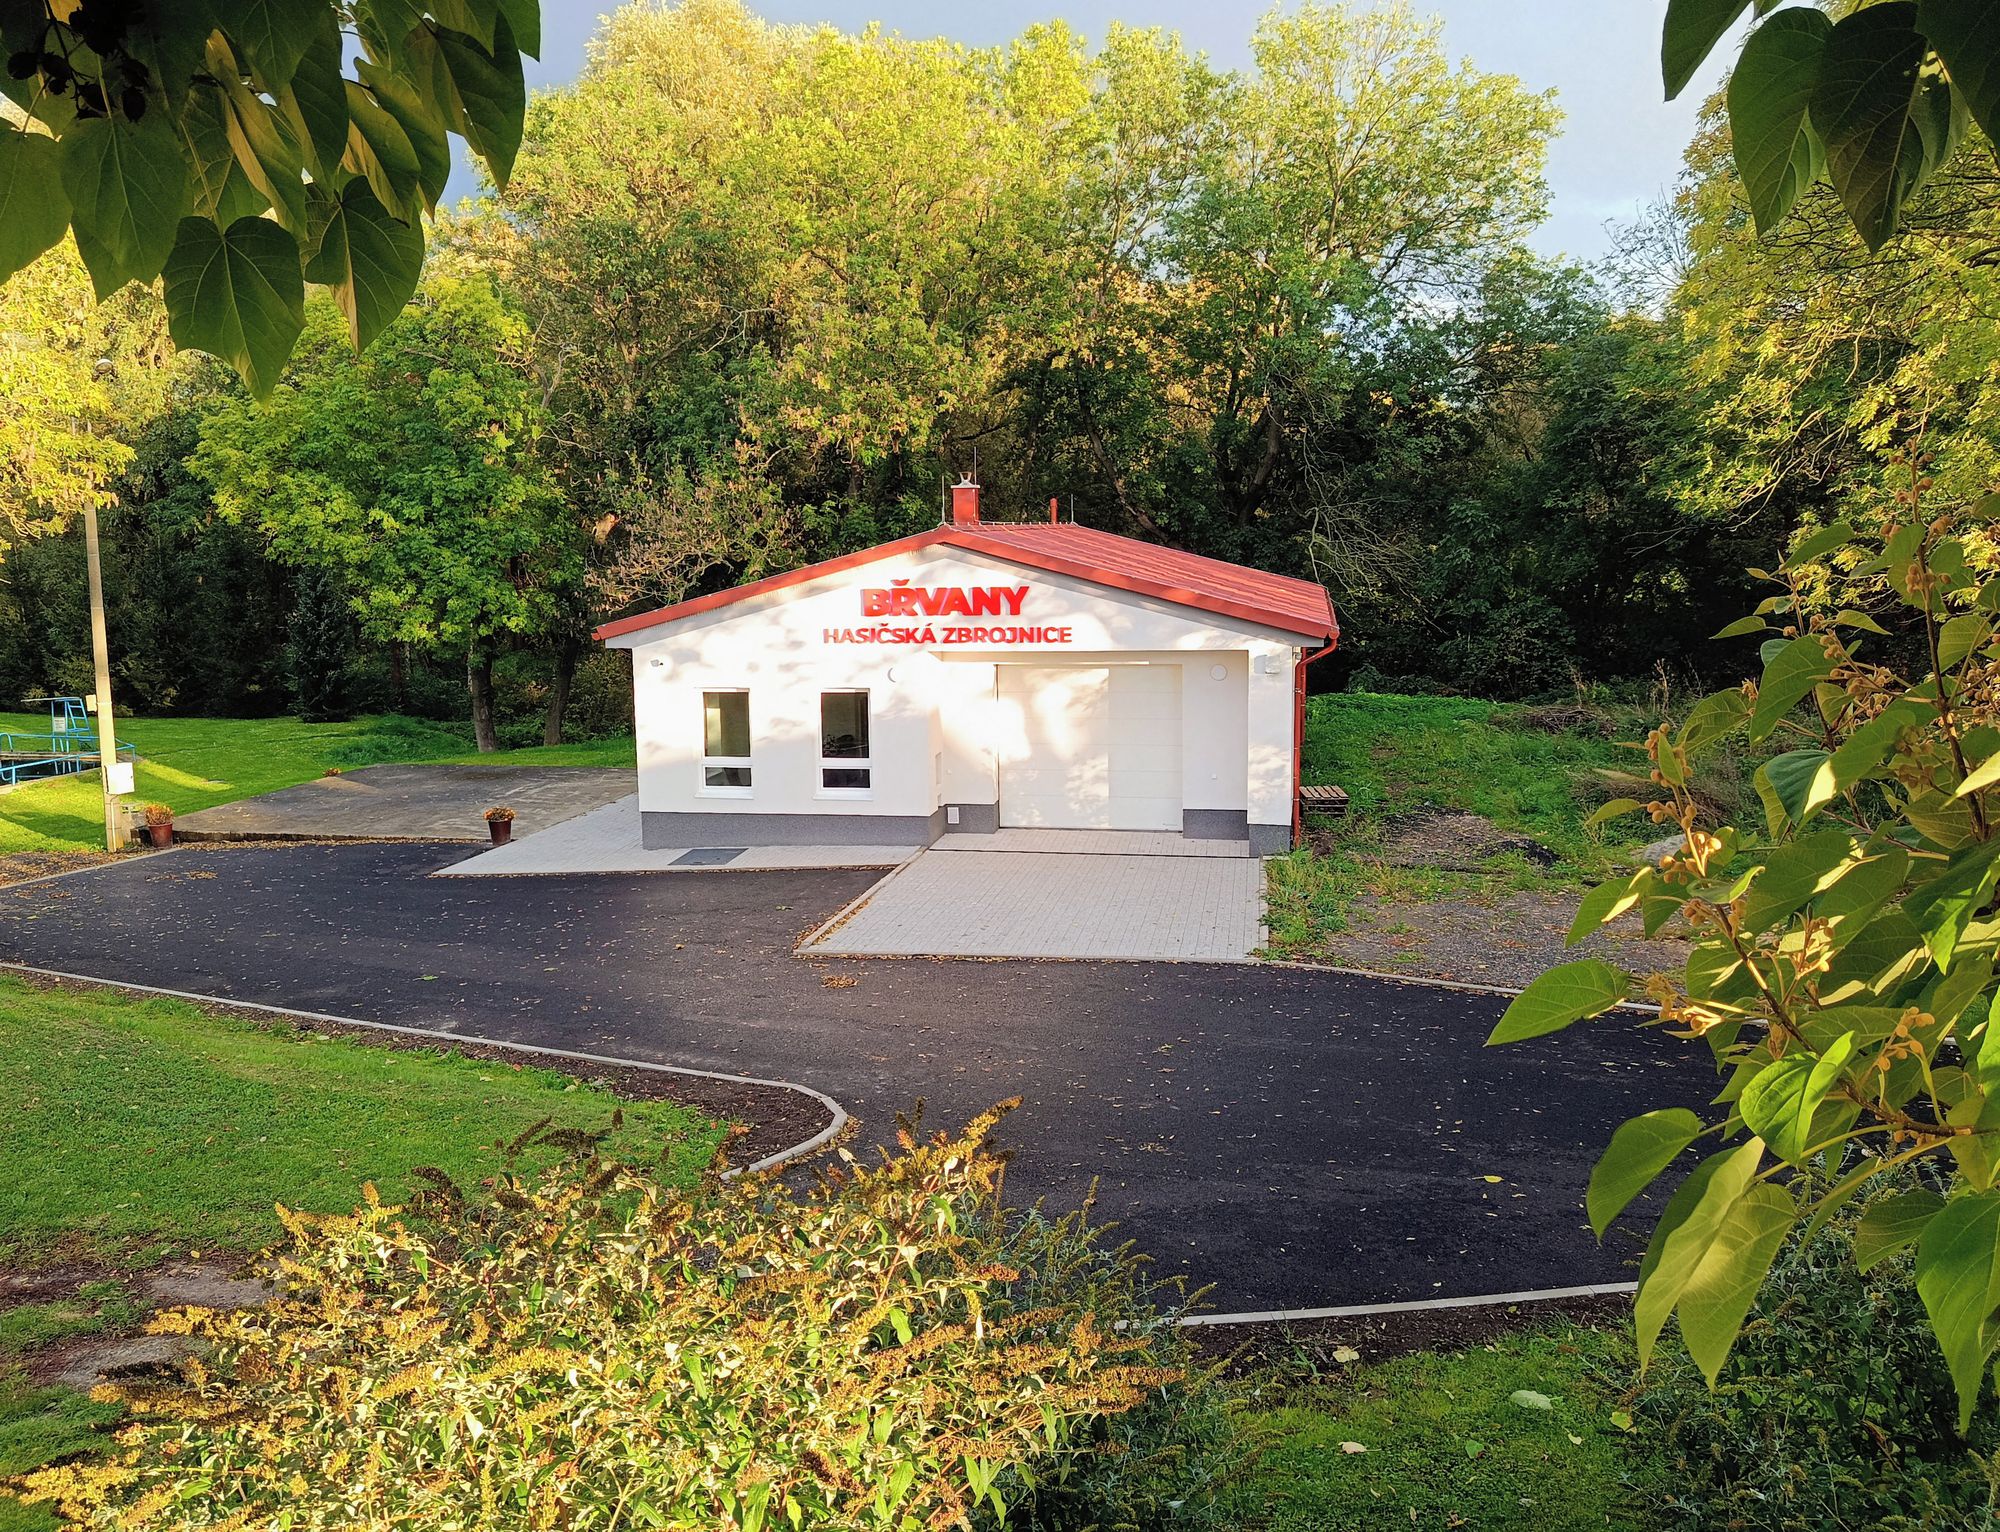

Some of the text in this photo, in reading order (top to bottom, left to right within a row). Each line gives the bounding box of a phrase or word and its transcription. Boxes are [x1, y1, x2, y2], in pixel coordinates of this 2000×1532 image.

[861, 578, 1030, 617] BŘVANY
[823, 622, 1073, 644] HASIČSKÁ ZBROJNICE
